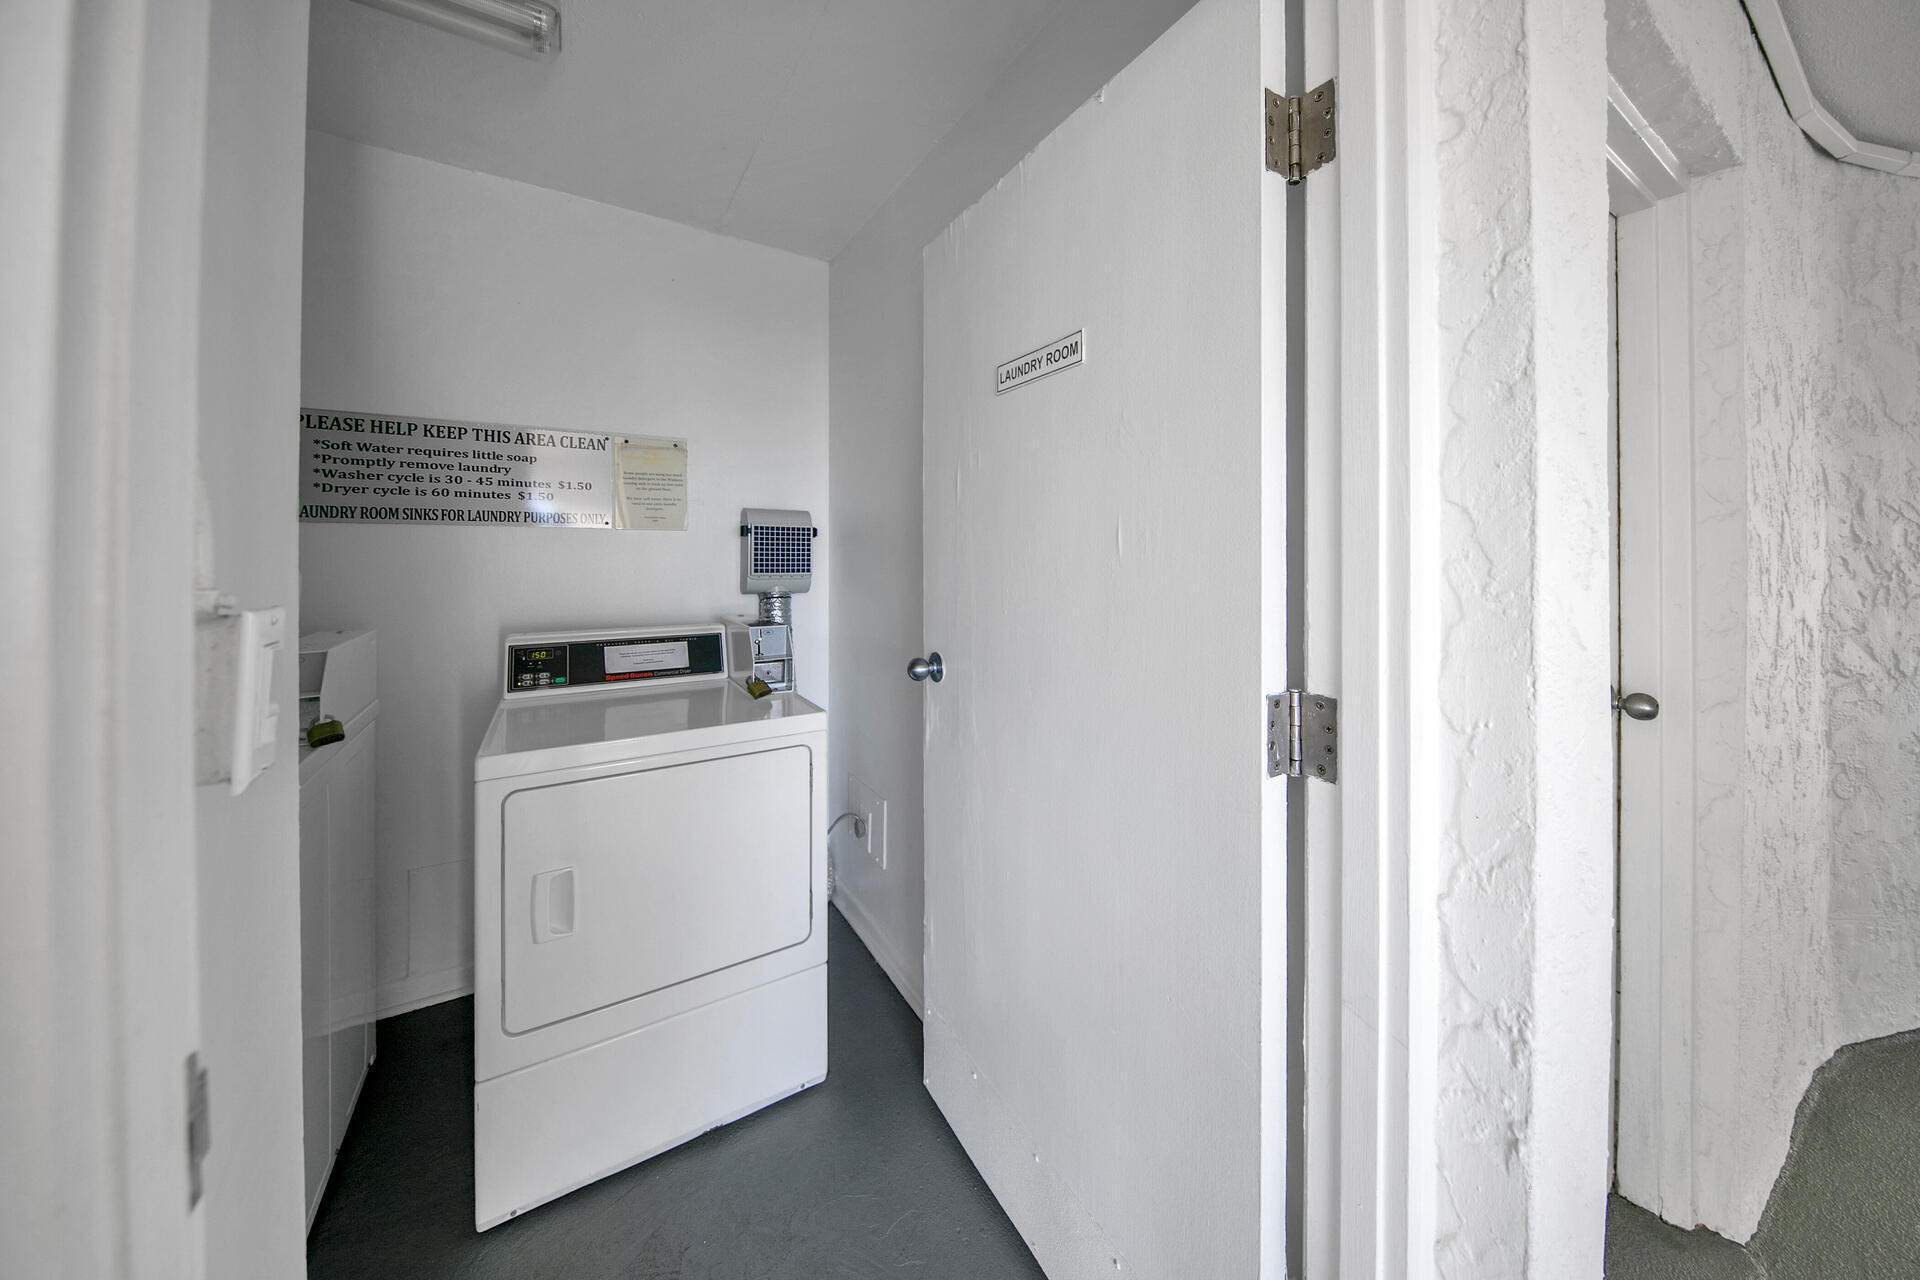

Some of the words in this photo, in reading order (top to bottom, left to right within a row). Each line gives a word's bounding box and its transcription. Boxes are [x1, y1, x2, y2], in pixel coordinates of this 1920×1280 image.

[1000, 355, 1043, 384] LAUNDRY
[1046, 341, 1079, 366] ROOM
[370, 420, 418, 437] HELP
[423, 424, 468, 440] KEEP
[472, 428, 511, 444] THIS
[515, 431, 556, 448] AREA
[560, 435, 606, 451] CLEAN
[356, 442, 404, 455] Water
[407, 447, 469, 459] requires
[472, 450, 504, 461] little
[507, 455, 537, 465] soap
[399, 461, 455, 471] remove
[458, 462, 512, 475] laundry
[388, 472, 425, 484] cycle
[429, 474, 441, 484] is
[444, 475, 463, 485] 30
[475, 476, 494, 486] 45
[498, 479, 552, 489] minutes
[558, 481, 592, 491] $1.50
[373, 486, 411, 497] cycle
[415, 487, 428, 496] is
[431, 488, 450, 497] 60
[454, 489, 511, 500] minutes
[518, 490, 554, 501] $1.50
[299, 504, 357, 519] AUNDRY
[360, 506, 399, 520] ROOM
[402, 507, 439, 521] SINKS
[441, 509, 465, 522] FOR
[468, 510, 521, 523] LAUNDRY
[524, 511, 578, 525] PURPOSES
[605, 673, 629, 682] Speed
